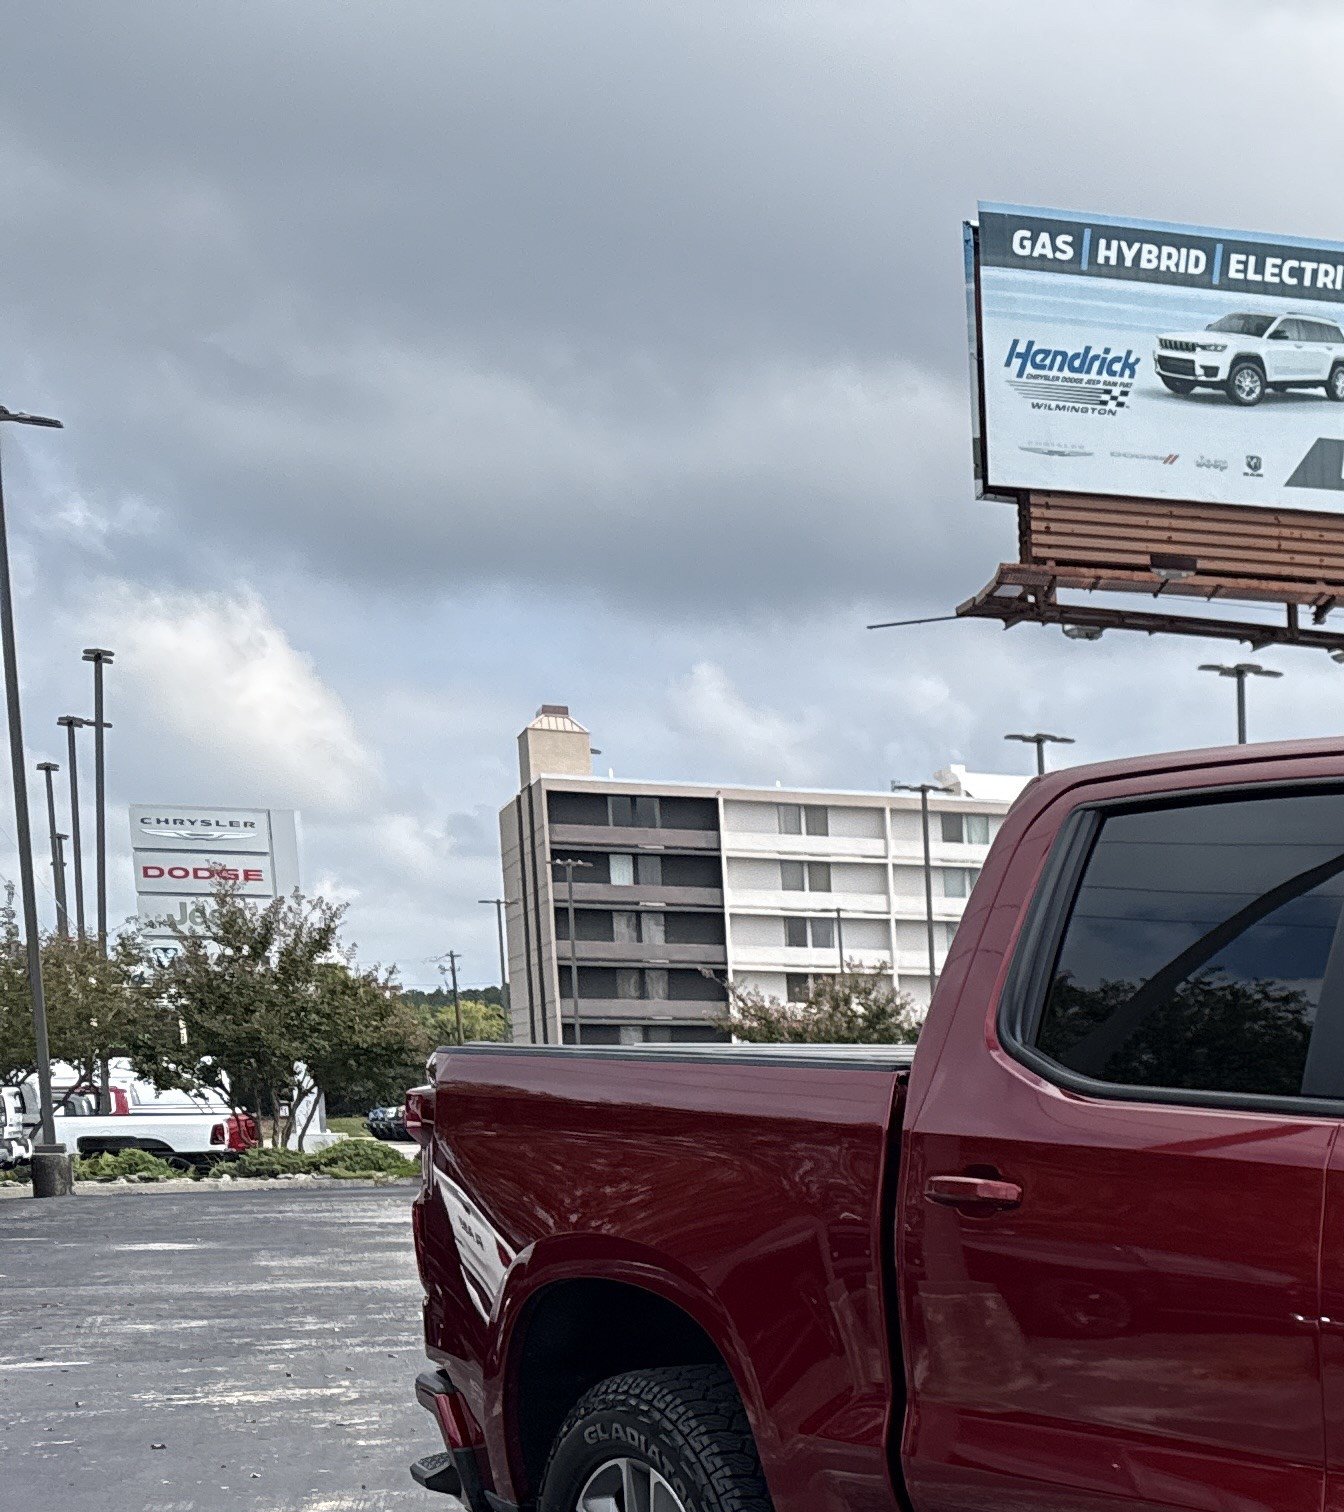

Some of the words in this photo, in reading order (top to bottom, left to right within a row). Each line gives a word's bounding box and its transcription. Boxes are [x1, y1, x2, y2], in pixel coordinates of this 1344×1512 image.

[1012, 229, 1074, 261] GAS
[1096, 238, 1207, 275] HYBRID
[1003, 339, 1141, 379] Hendrick
[1031, 401, 1117, 416] WILMINGTON
[140, 817, 256, 829] CHRYSLER
[142, 866, 264, 882] DODGE
